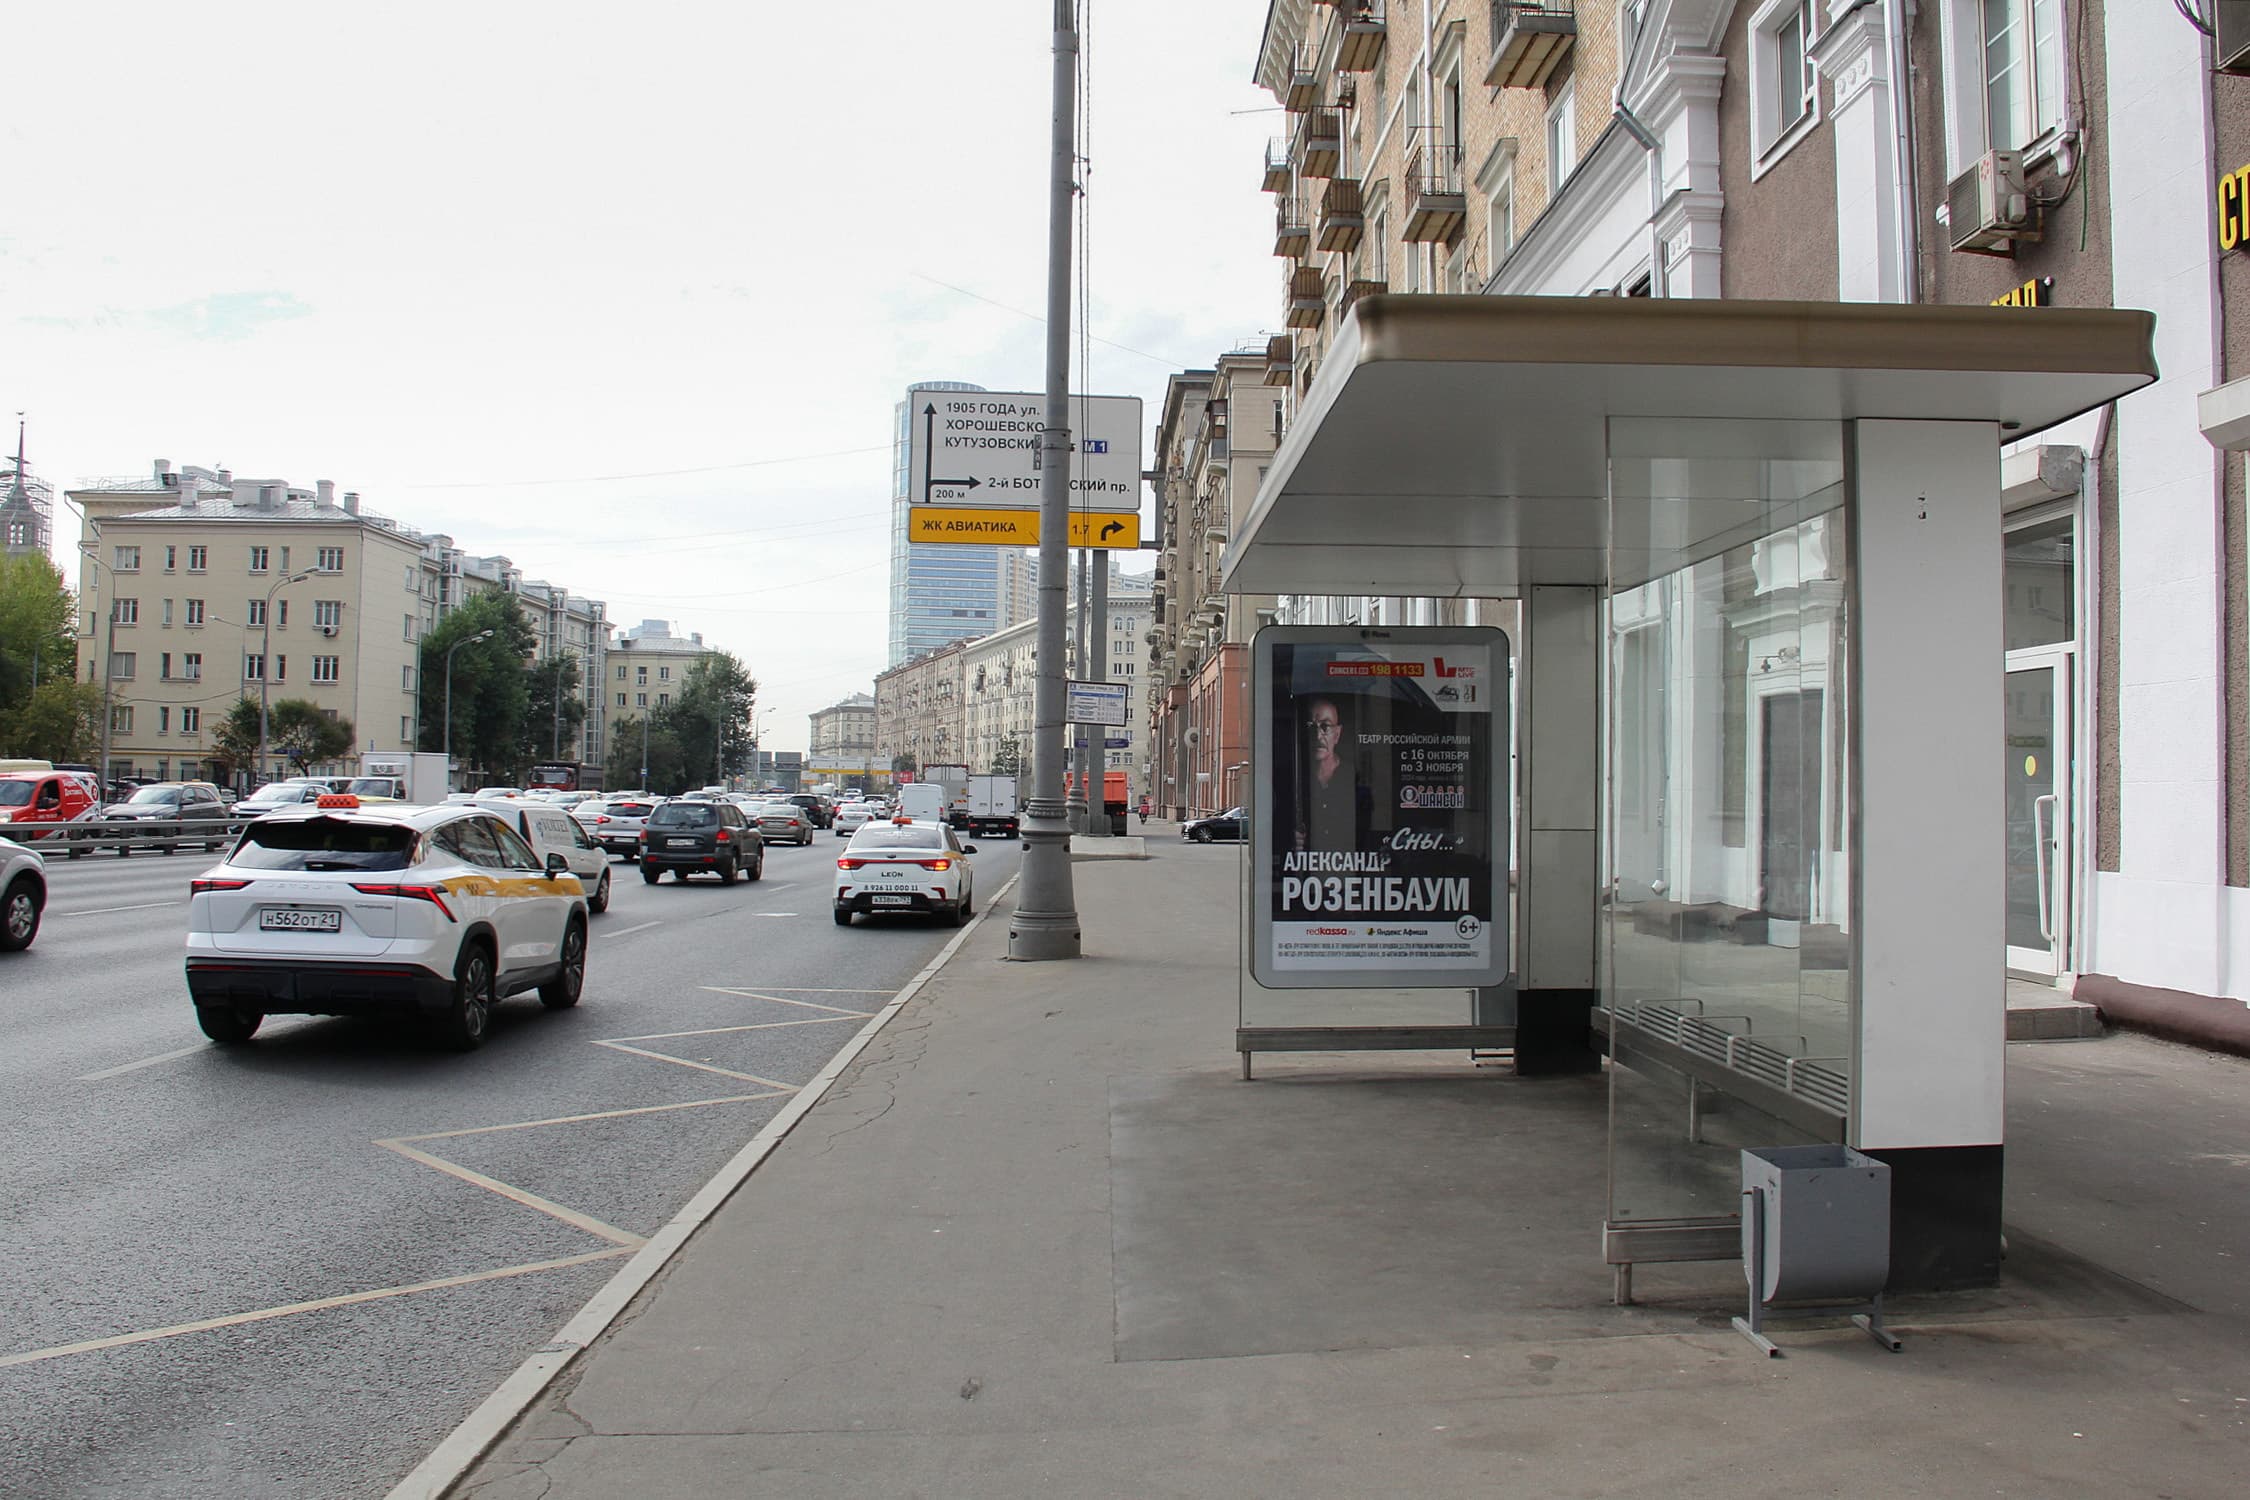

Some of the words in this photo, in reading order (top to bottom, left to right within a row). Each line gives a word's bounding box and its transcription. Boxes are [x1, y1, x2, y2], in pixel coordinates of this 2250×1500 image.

[946, 402, 976, 414] 1905
[980, 403, 1016, 416] ГОДА
[1020, 406, 1040, 417] ул.
[946, 418, 1045, 433] ХОРОШЕВСКО
[945, 436, 1034, 450] КУТУЗОВСКИ
[988, 476, 1009, 488] 2-й
[1110, 483, 1130, 494] пр.
[936, 489, 956, 498] 200
[922, 520, 942, 532] ЖК
[946, 520, 1016, 533] АВИАТИКА
[1370, 664, 1392, 675] 198
[1394, 664, 1423, 675] 1133
[1358, 734, 1381, 744] ТЕАТР
[1383, 733, 1440, 744] РОССИЙСКОЙ
[1441, 735, 1471, 745] АРМИИ
[1400, 751, 1407, 760] с
[1411, 749, 1424, 760] 16
[1427, 751, 1469, 760] ОКТЯБРЯ
[1400, 763, 1412, 772] по
[1416, 761, 1423, 772] 3
[1426, 763, 1464, 772] НОЯБРЯ
[1284, 852, 1391, 872] АЛЕКСАНДР
[1282, 876, 1470, 911] РОЗЕНБАУМ
[1377, 928, 1400, 937] Яндекс
[1403, 928, 1428, 936] Афиша
[1458, 919, 1479, 934] 6+
